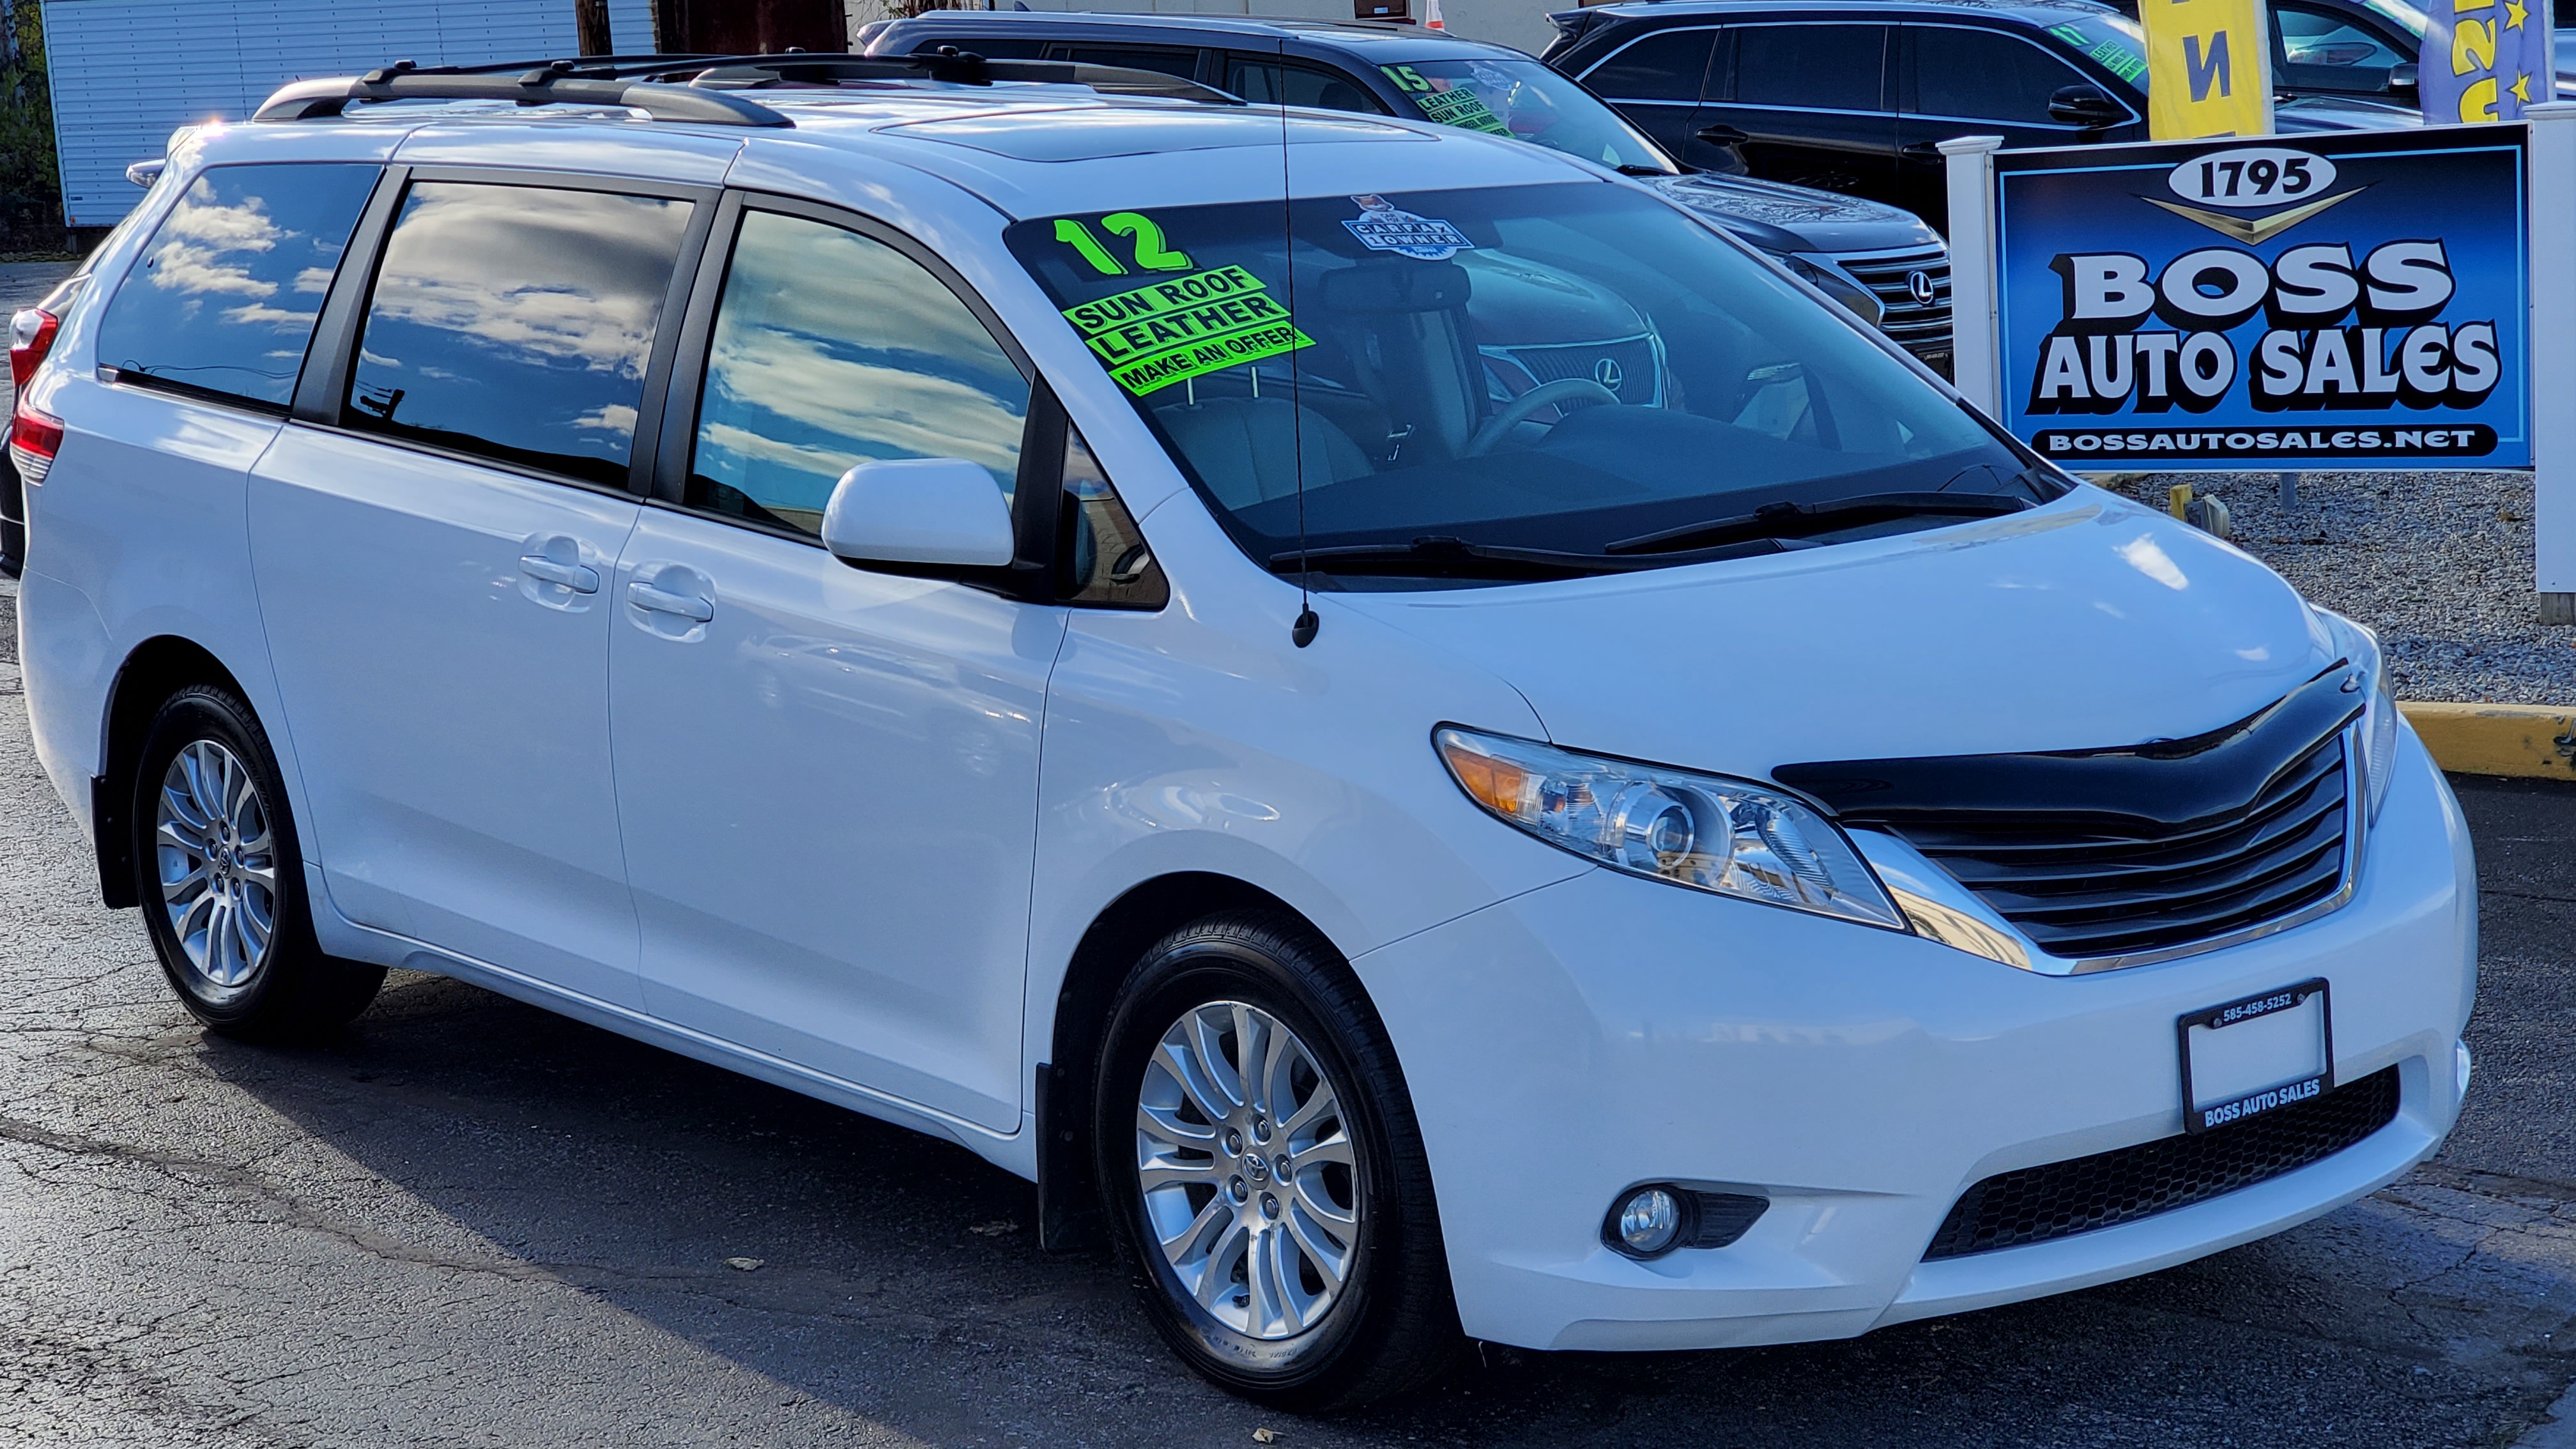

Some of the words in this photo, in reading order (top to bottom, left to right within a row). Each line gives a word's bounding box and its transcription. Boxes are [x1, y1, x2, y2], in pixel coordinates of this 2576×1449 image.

[2049, 26, 2090, 46] 17
[1380, 66, 1431, 91] 15
[1418, 88, 1475, 111] LEATHER
[1431, 107, 1458, 123] SUN
[1458, 101, 1487, 116] ROOF
[2201, 157, 2312, 198] 1795
[1053, 212, 1193, 275] 12
[1355, 223, 1450, 234] CARFAX
[1368, 236, 1381, 245] 1
[1383, 234, 1462, 245] OWNER
[2073, 240, 2454, 319] BOSS
[1075, 294, 1154, 330] SUN
[1153, 267, 1251, 309] ROOF
[1098, 296, 1276, 358] LEATHER
[1123, 353, 1192, 388] MAKE
[1195, 342, 1224, 367] AN
[1225, 326, 1297, 355] OFFER
[2039, 330, 2235, 399] AUTO
[2260, 325, 2501, 395] SALES
[2049, 429, 2476, 453] BOSSAUTOSALES.NET
[2223, 993, 2292, 1022] 585-458-5252
[2205, 1101, 2241, 1128] BOSS
[2242, 1092, 2278, 1116] AUTO
[2279, 1078, 2320, 1105] SALES
